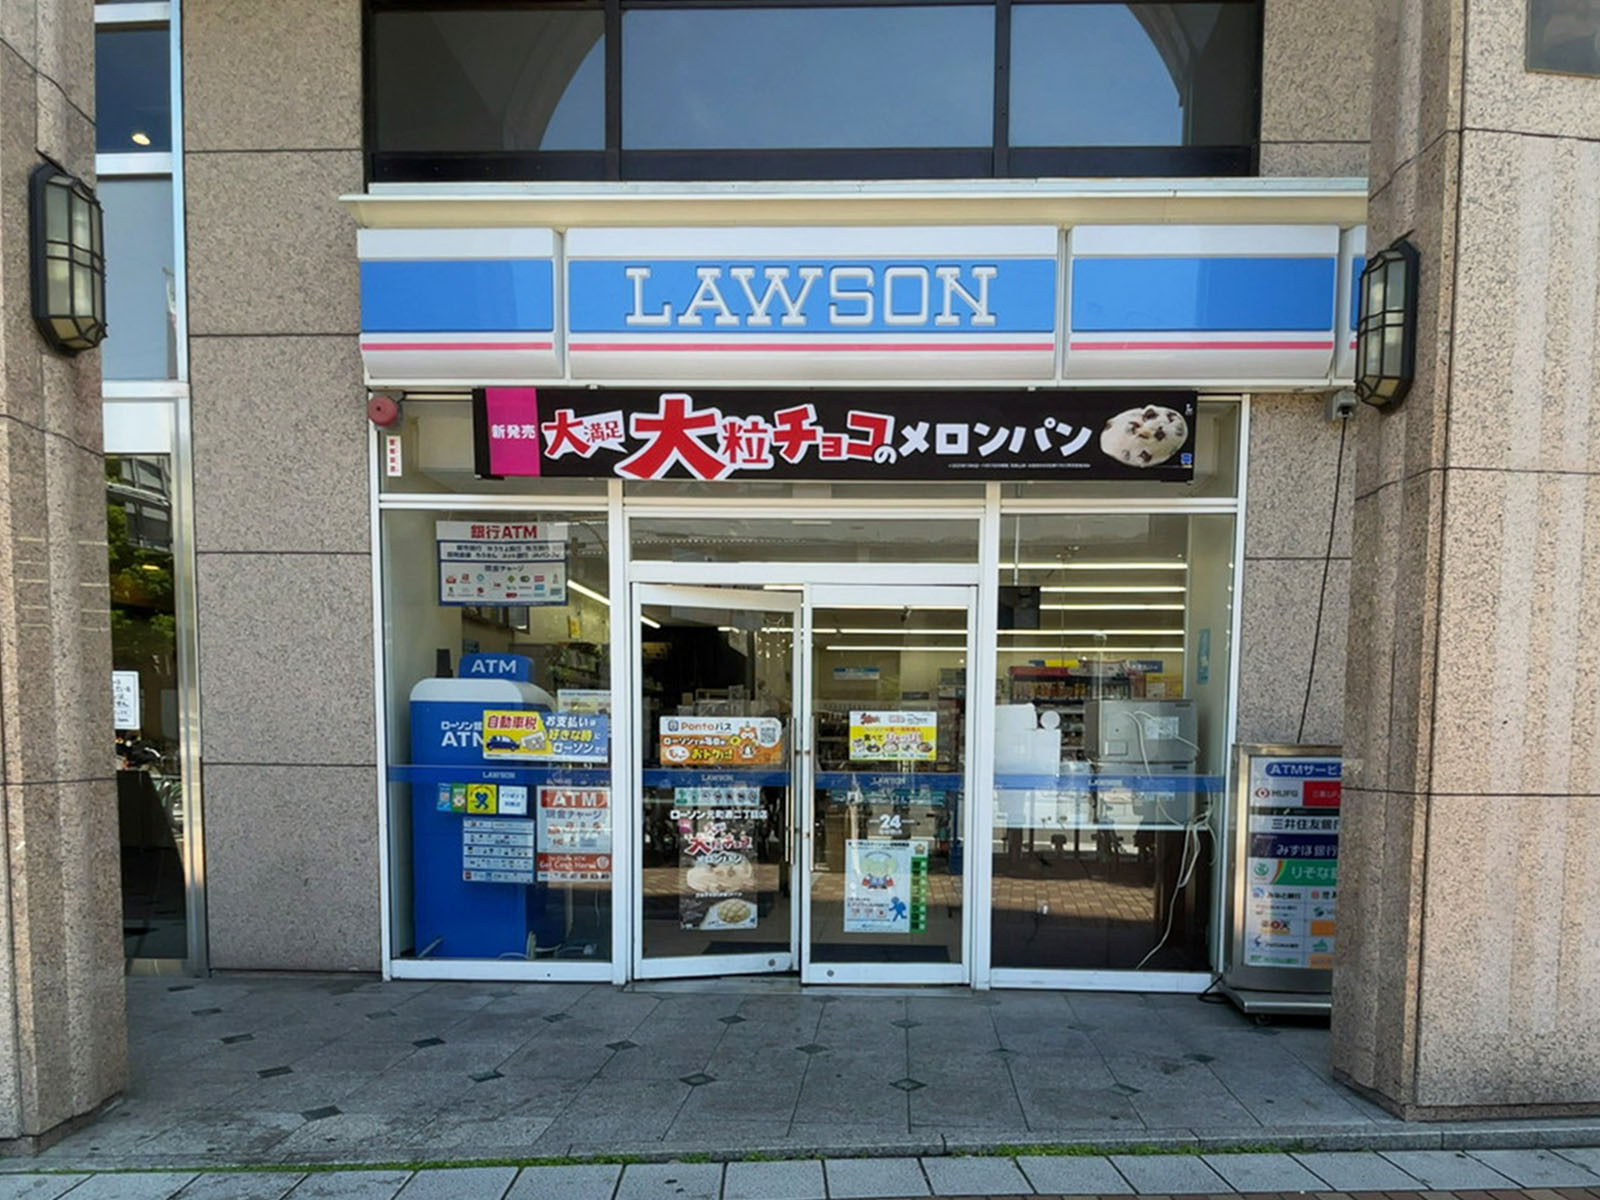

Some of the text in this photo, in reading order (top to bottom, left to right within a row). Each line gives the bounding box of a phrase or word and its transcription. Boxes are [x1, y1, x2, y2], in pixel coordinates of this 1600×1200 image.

[625, 266, 997, 327] LAWSON
[491, 423, 537, 439] 新発売
[541, 408, 626, 456] 大満足
[471, 525, 537, 539] 銀行ATM
[471, 659, 517, 674] ATM
[487, 715, 538, 730] 自動車税
[681, 722, 732, 731] Pontaパス
[1270, 764, 1341, 775] ATMサービ
[553, 792, 598, 807] ATM
[880, 814, 901, 829] 24
